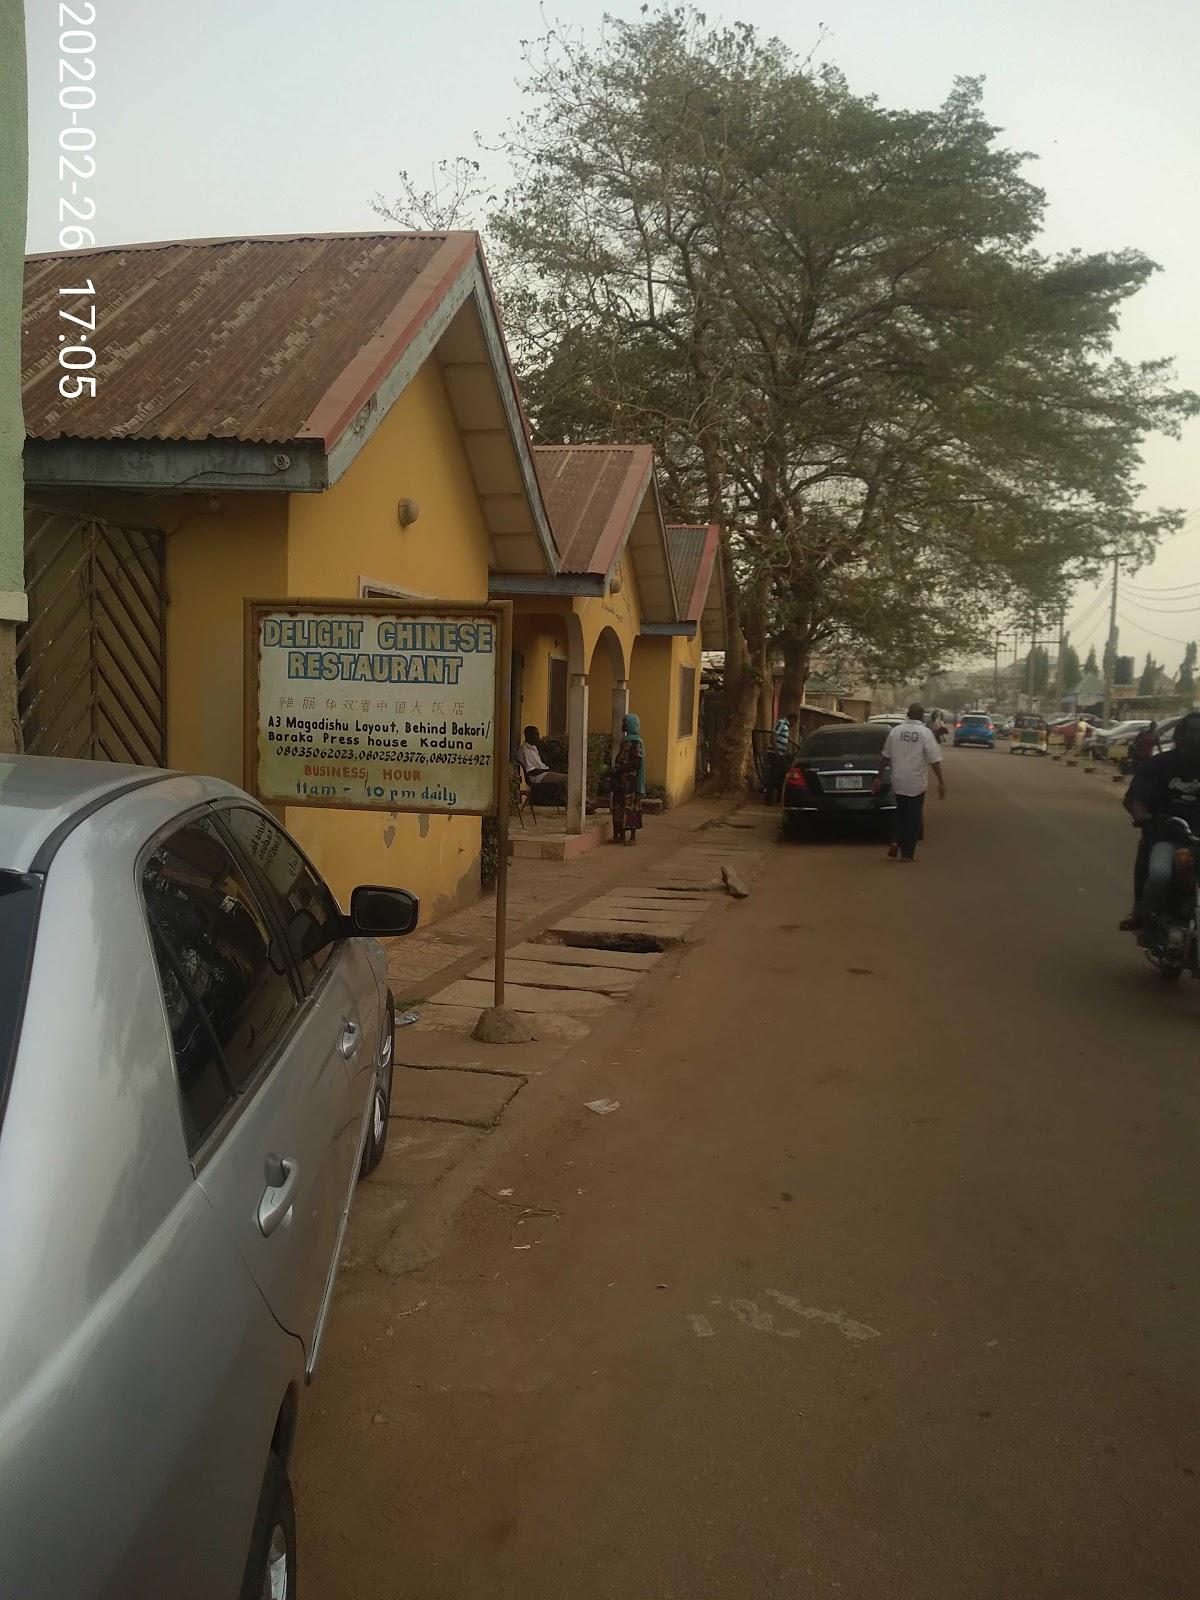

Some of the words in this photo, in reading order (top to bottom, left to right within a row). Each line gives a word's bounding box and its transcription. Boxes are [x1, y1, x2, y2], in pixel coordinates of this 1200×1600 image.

[263, 619, 364, 649] DELIGHT
[377, 621, 493, 653] CHINESE
[288, 651, 464, 684] RESTAURANT
[268, 716, 281, 728] A3
[286, 716, 349, 733] Magadishu
[355, 720, 399, 735] Layout,
[405, 721, 447, 735] Behind
[268, 731, 314, 743] Baraka
[323, 732, 360, 746] Press
[367, 736, 408, 748] house
[420, 736, 473, 751] Kaduna
[304, 765, 366, 779] BUSINESS
[383, 769, 421, 781] HOUR
[422, 783, 457, 805] daily
